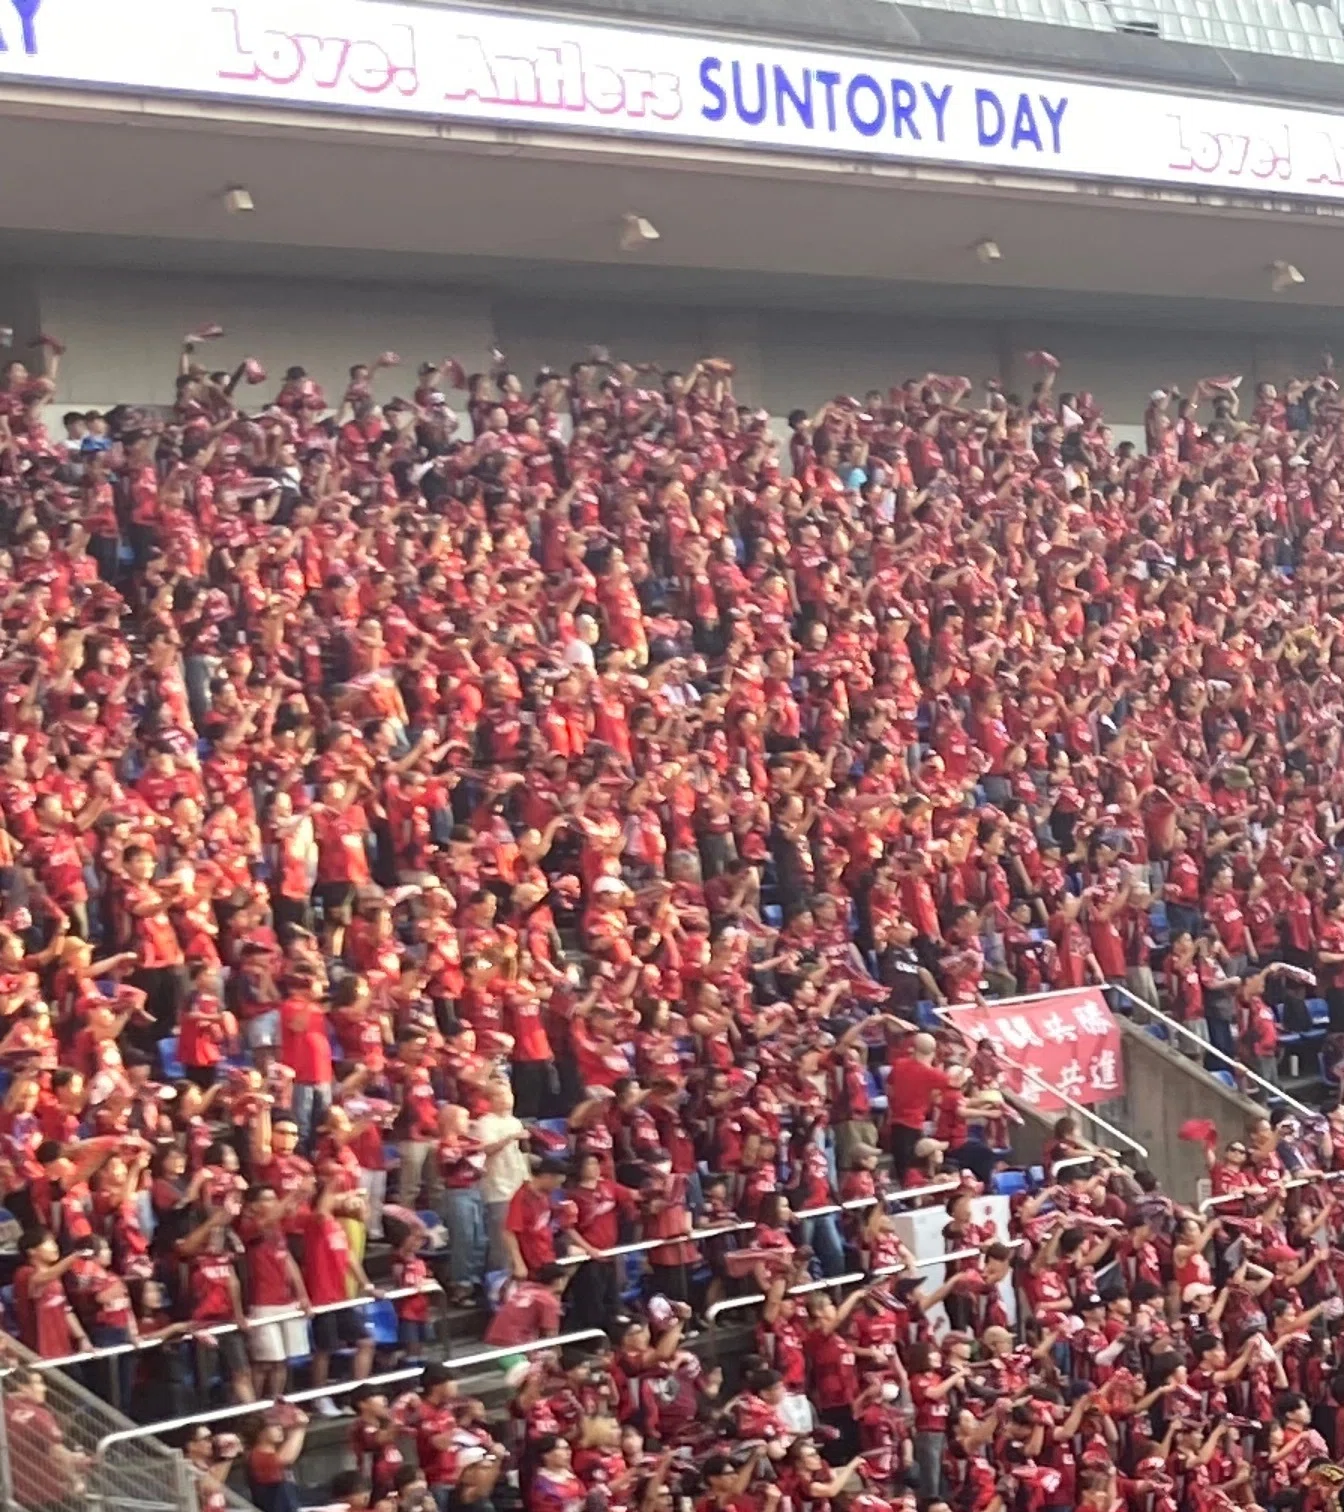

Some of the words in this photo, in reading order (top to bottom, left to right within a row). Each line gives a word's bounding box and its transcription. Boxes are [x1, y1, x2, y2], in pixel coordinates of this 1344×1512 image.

[443, 34, 684, 121] Antlers
[700, 56, 952, 146] SUNTORY
[976, 92, 1070, 155] DAY
